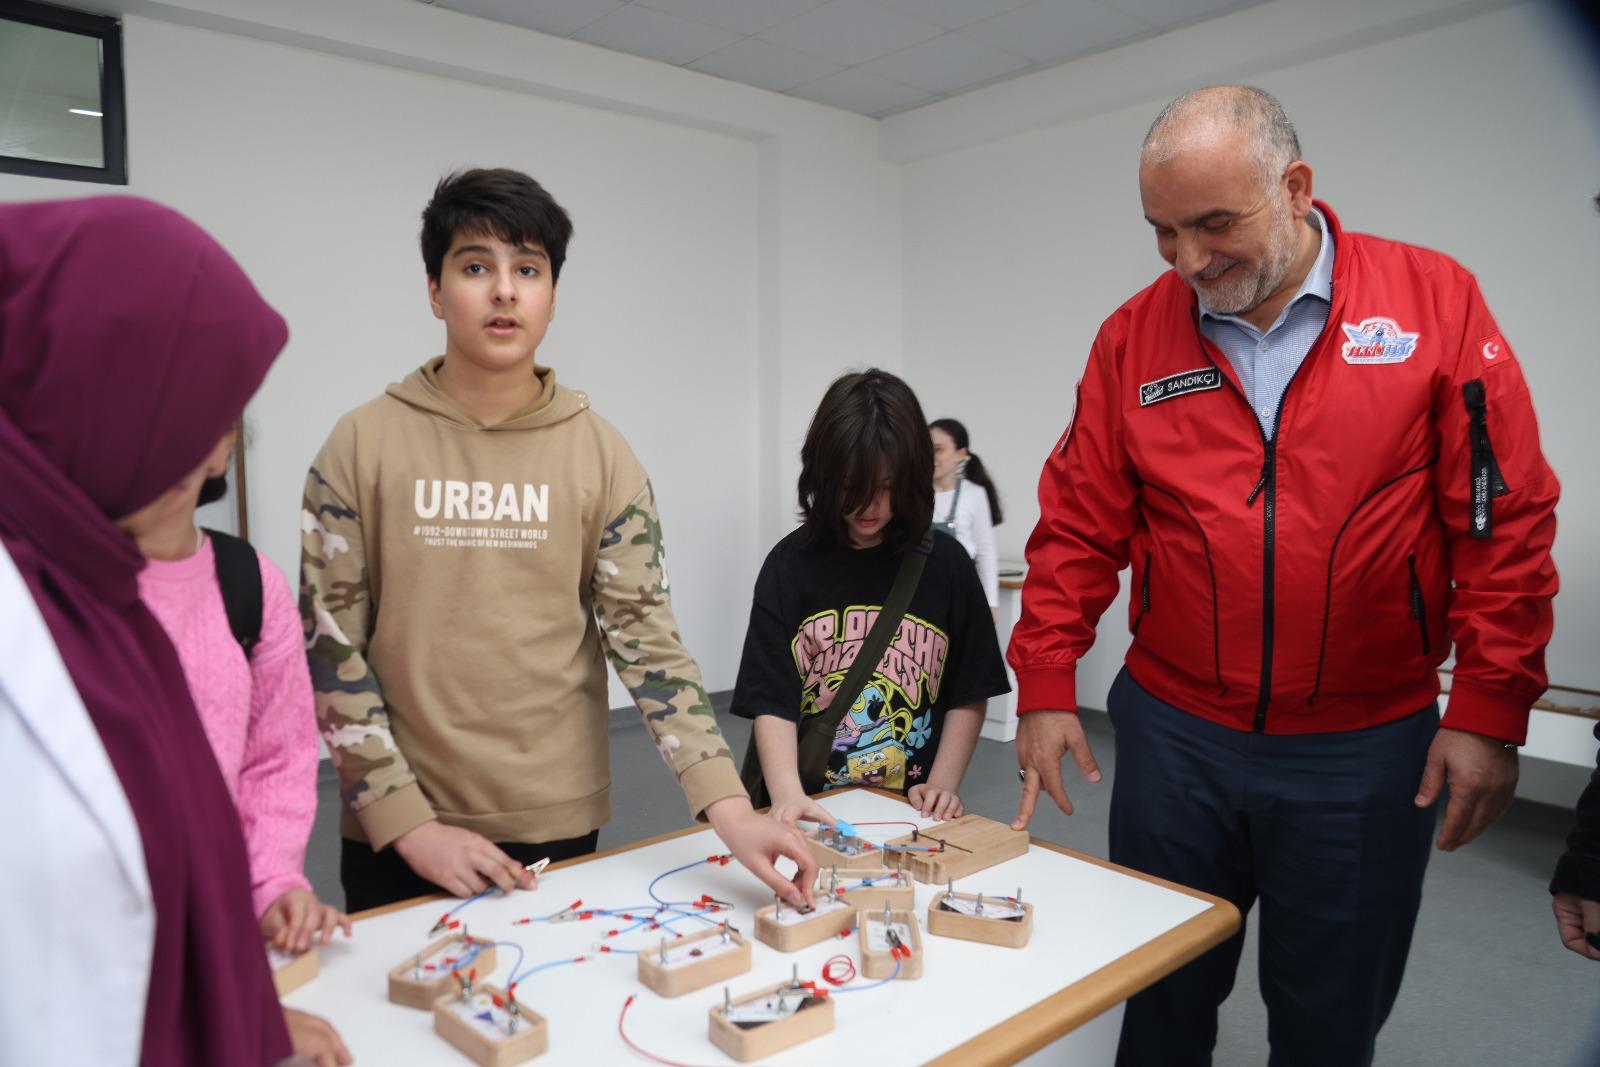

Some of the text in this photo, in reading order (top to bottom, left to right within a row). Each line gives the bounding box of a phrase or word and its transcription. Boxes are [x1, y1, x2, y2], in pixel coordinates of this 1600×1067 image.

[414, 479, 549, 522] URBAN
[490, 528, 519, 539] STREET
[520, 529, 548, 541] WORLD
[893, 615, 949, 701] THE
